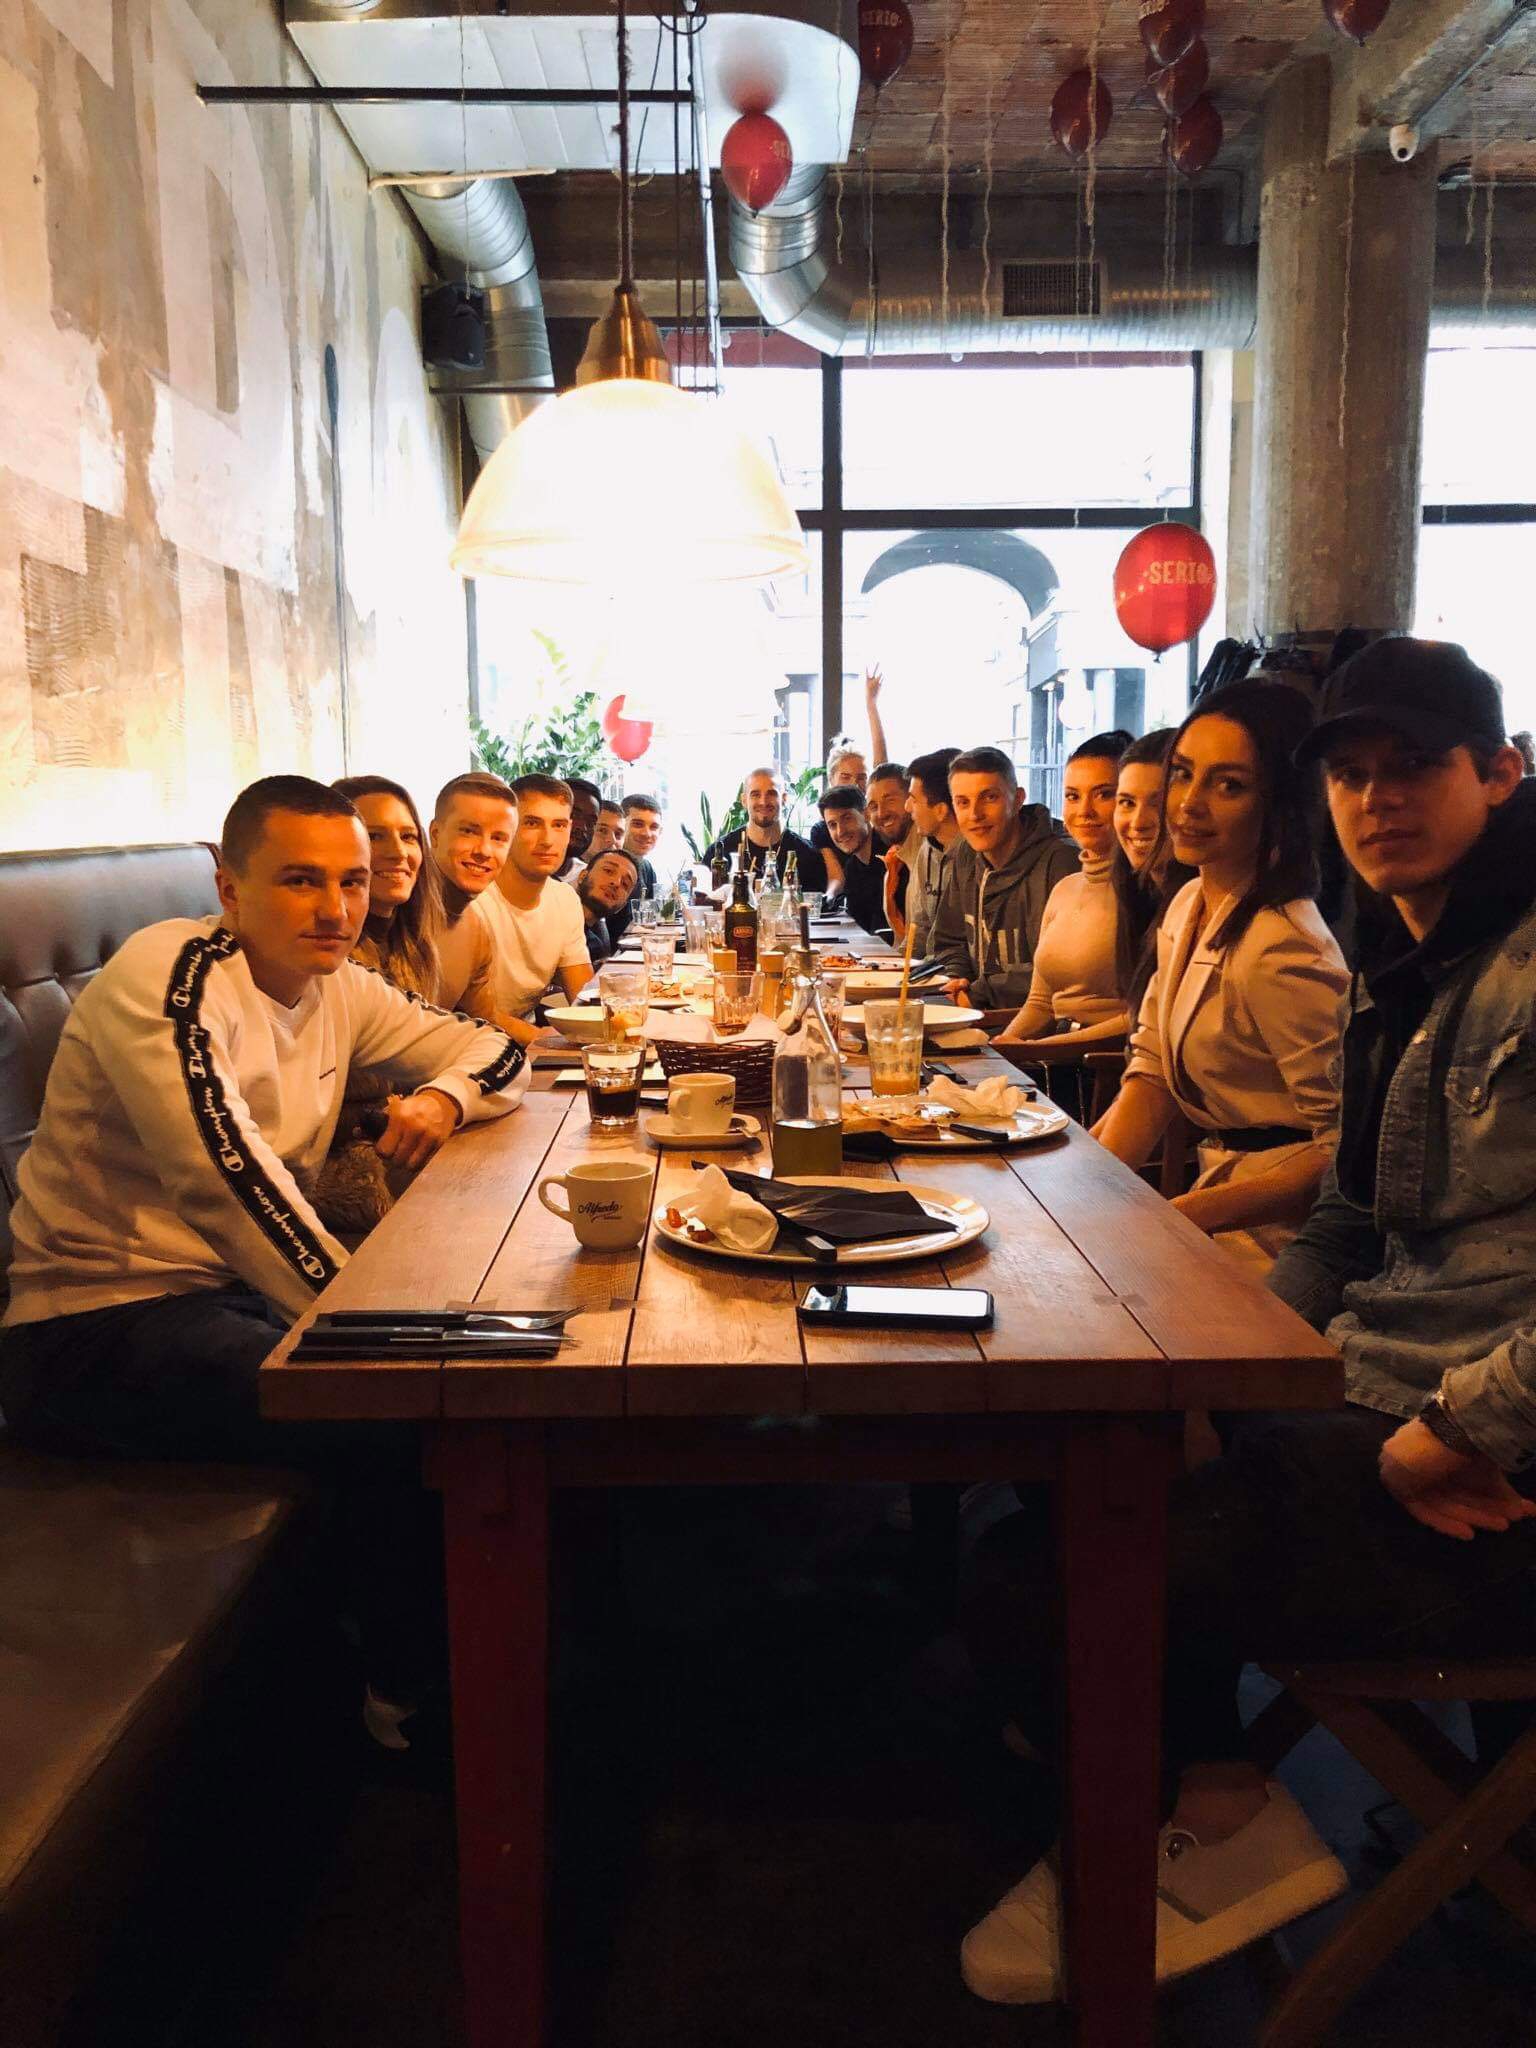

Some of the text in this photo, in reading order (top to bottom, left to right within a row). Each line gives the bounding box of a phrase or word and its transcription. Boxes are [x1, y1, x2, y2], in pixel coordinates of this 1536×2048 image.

[1149, 560, 1208, 585] SERIO
[204, 1086, 245, 1172] Champion
[251, 1185, 325, 1279] Champion
[577, 1200, 620, 1216] Alfredo
